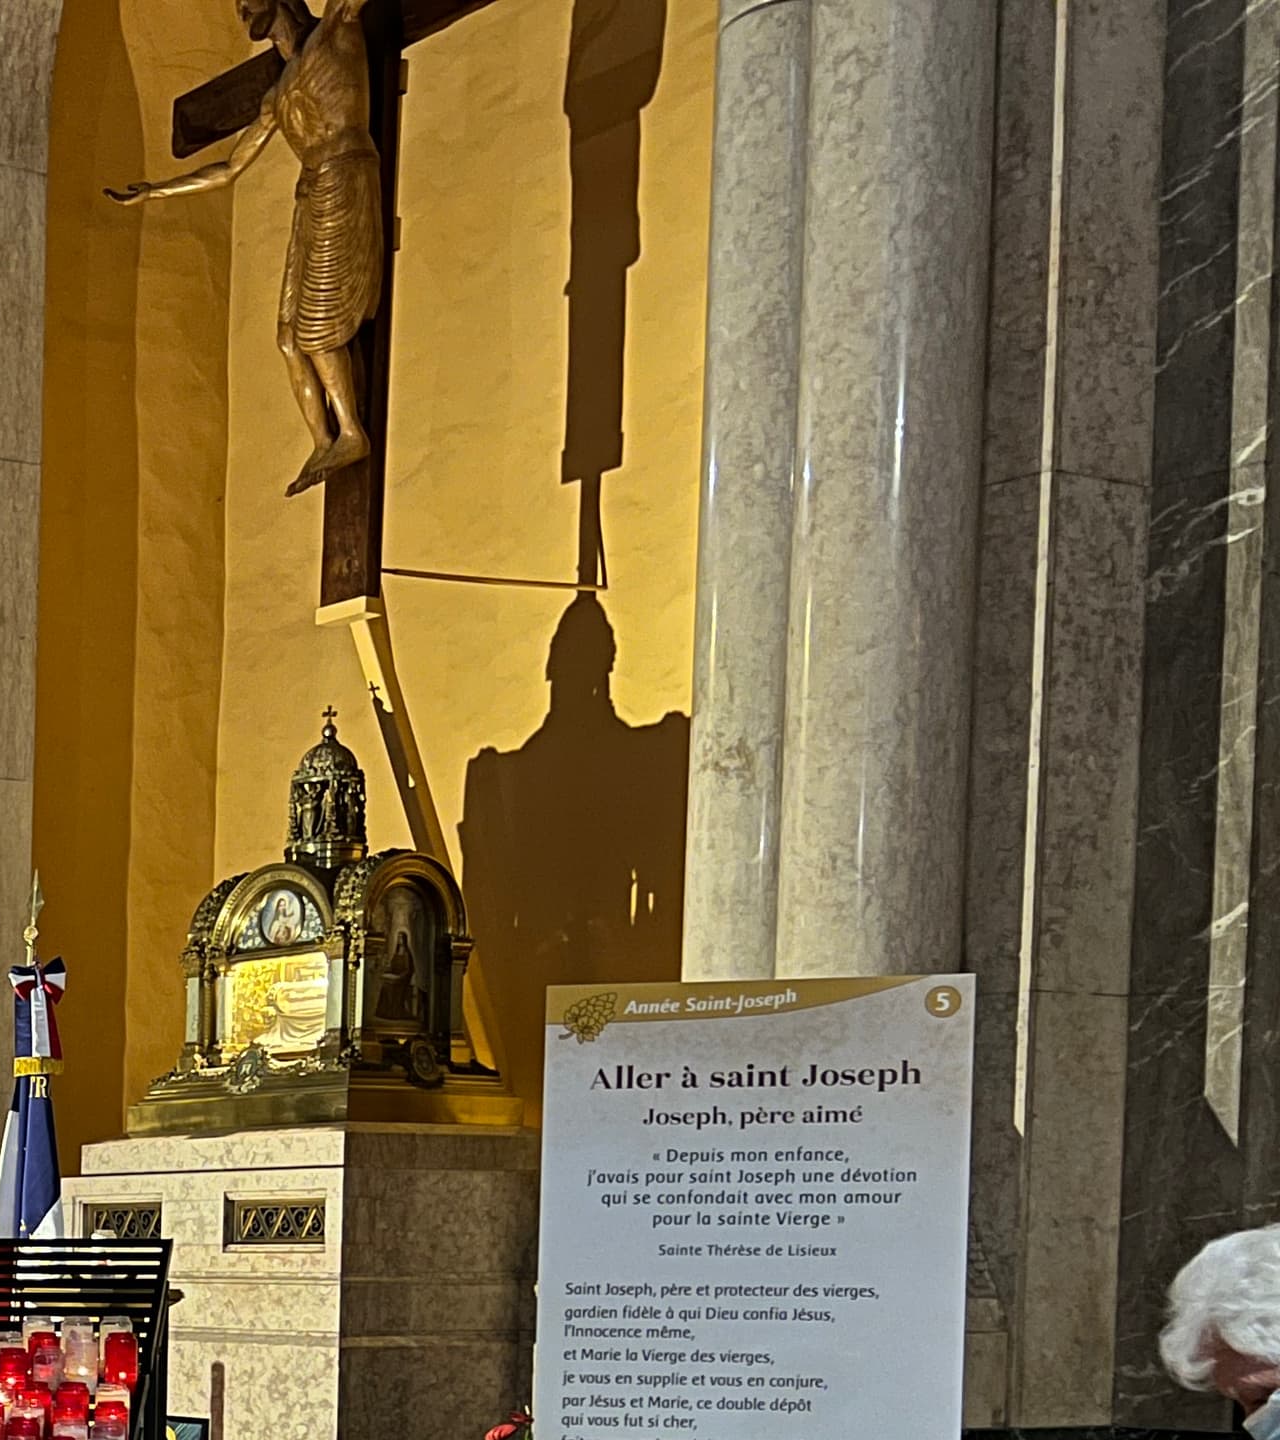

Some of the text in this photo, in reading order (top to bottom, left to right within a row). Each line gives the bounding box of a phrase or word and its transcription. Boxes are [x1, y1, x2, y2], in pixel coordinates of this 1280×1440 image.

[624, 989, 796, 1014] Année Saint-Joseph
[936, 993, 949, 1010] 5
[591, 1060, 920, 1092] Aller à saint Joseph
[643, 1105, 862, 1130] Joseph, père aimé
[667, 1148, 724, 1165] Depuis
[731, 1151, 767, 1162] mon
[775, 1146, 849, 1163] enfance,
[645, 1173, 684, 1186] pour
[689, 1169, 731, 1183] saint
[737, 1169, 795, 1186] Joseph
[803, 1172, 834, 1182] une
[841, 1168, 916, 1182] dévotion
[601, 1189, 902, 1208] qui se confondait avec mon amour
[653, 1215, 691, 1228] pour
[697, 1211, 711, 1225] la
[718, 1211, 770, 1225] sainte
[776, 1211, 830, 1228] Vierge
[659, 1244, 836, 1256] Sainte Thérèse de Lisieux
[565, 1282, 879, 1300] Saint Joseph, père et protecteur des vierges,
[565, 1305, 835, 1323] gardien fidèle à qui Dieu confia Jésus,
[646, 1326, 695, 1341] même,
[563, 1348, 774, 1366] et Marie la Vierge des vierges,
[562, 1370, 828, 1390] je vous en supplie et vous en conjure,
[562, 1395, 811, 1414] par Jésus et Marie, ce double dépôt
[561, 1413, 697, 1430] qui vous fut si cher,
